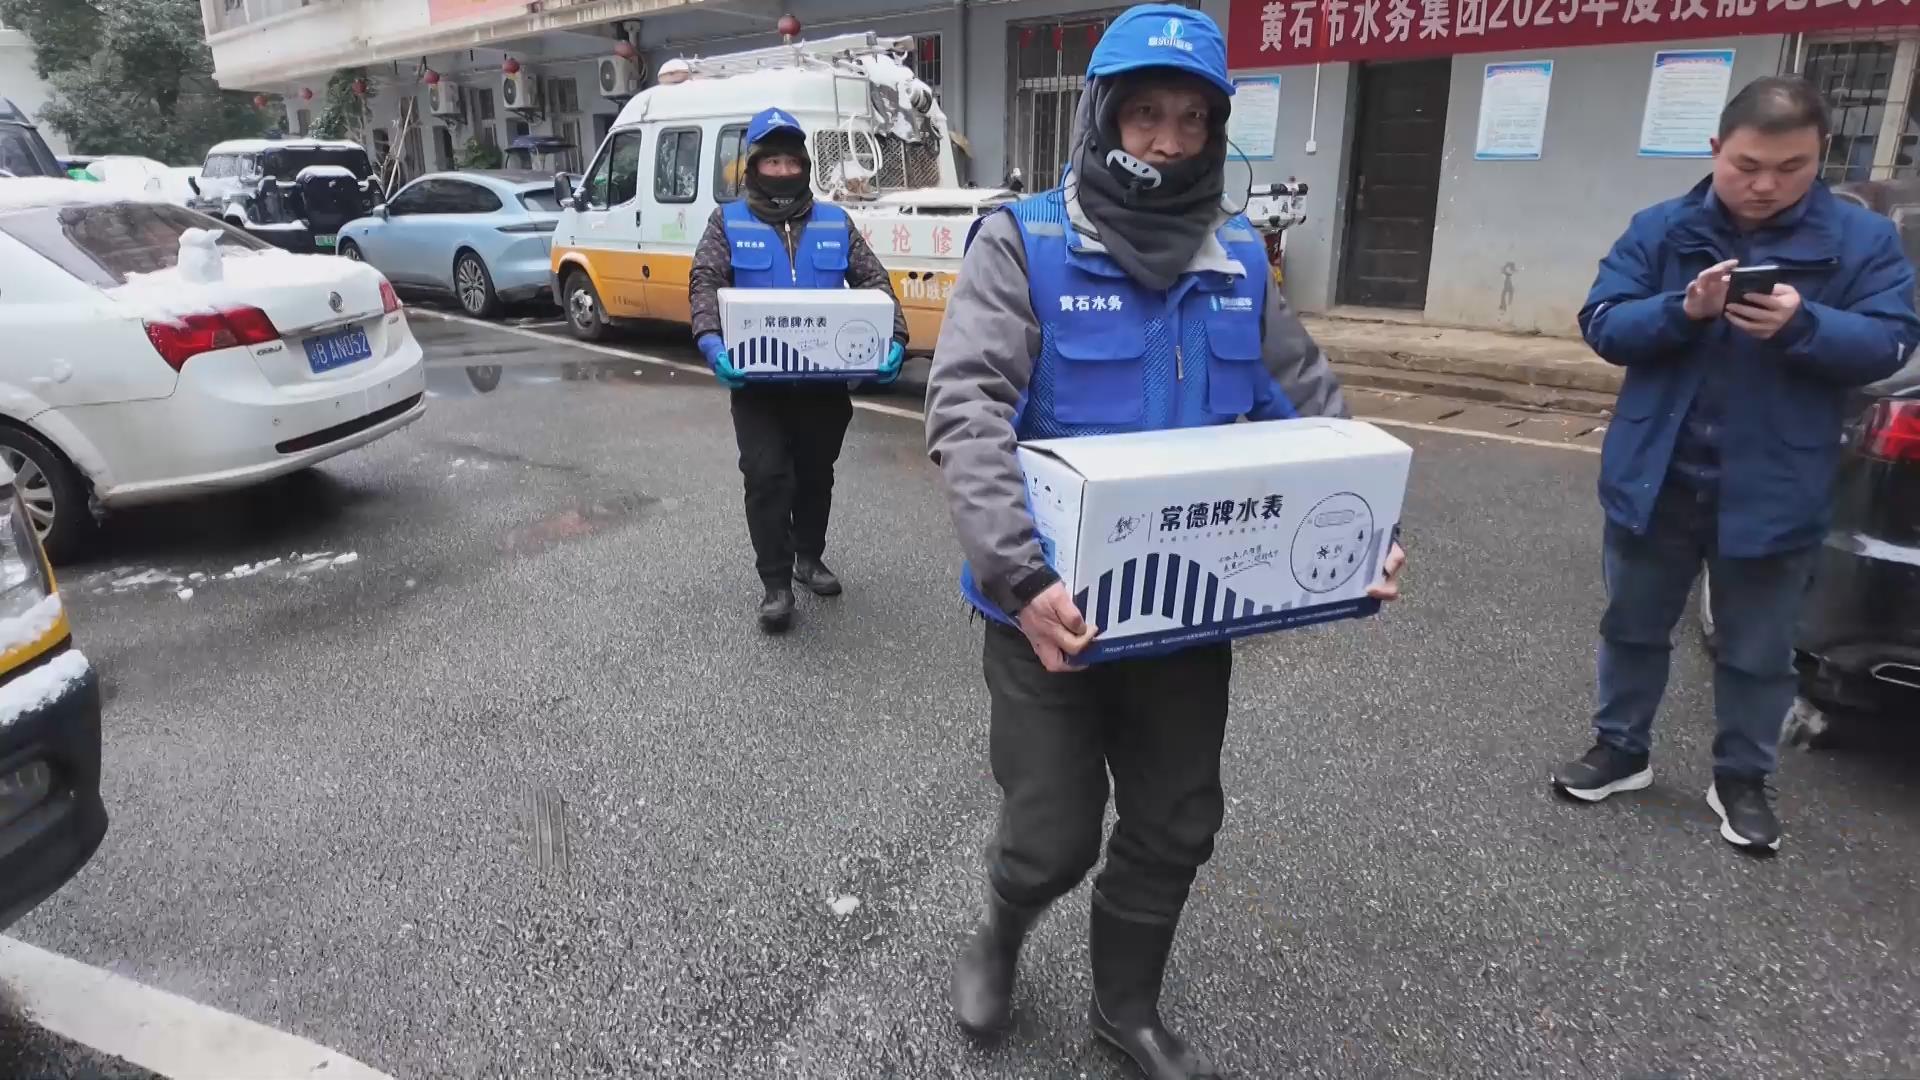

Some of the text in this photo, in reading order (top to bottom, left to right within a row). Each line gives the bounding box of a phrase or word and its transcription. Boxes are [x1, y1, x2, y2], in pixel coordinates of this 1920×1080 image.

[1059, 295, 1123, 312] 黄石水务
[765, 315, 827, 329] 常德牌水表
[1159, 493, 1284, 532] 常德牌水表
